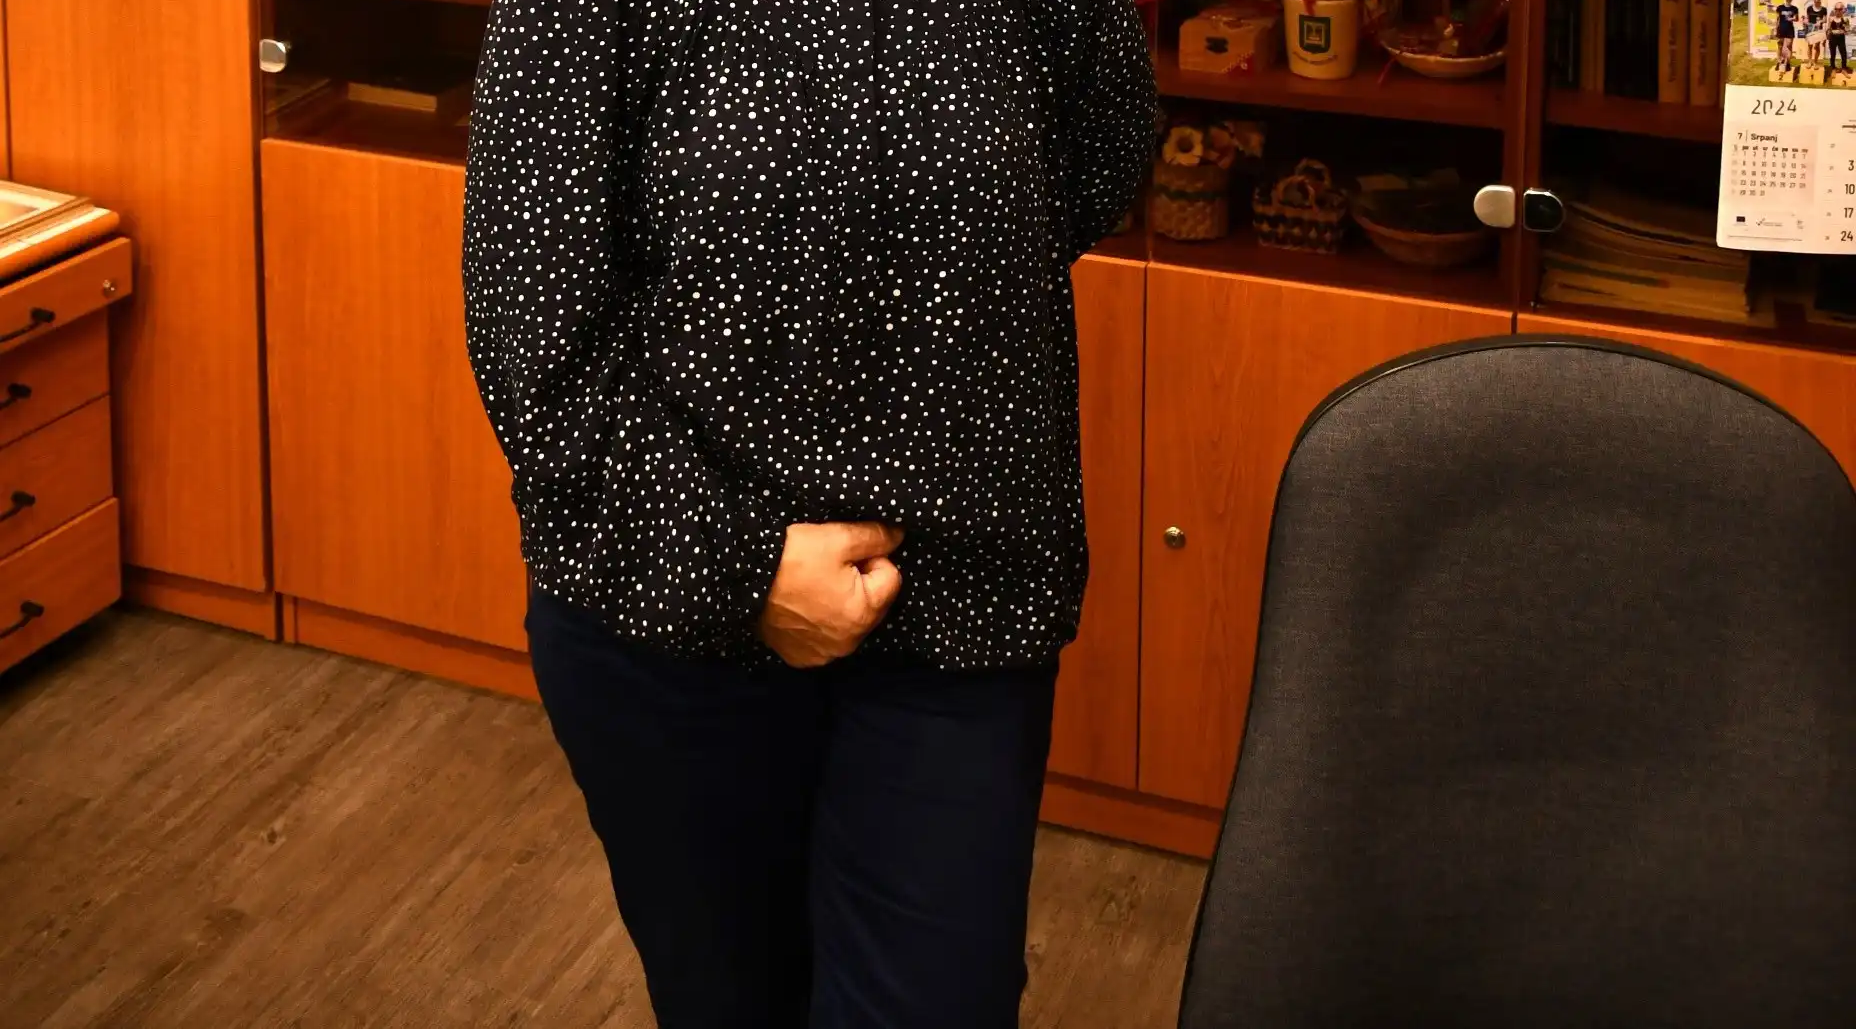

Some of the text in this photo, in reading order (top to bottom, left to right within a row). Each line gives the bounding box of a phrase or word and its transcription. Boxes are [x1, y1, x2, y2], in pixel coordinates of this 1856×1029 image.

[1751, 98, 1797, 116] 2024
[1737, 132, 1778, 143] 7 Srpanj
[1848, 159, 1855, 171] 3
[1845, 183, 1855, 195] 10
[1844, 207, 1854, 218] 17
[1841, 230, 1853, 242] 24
